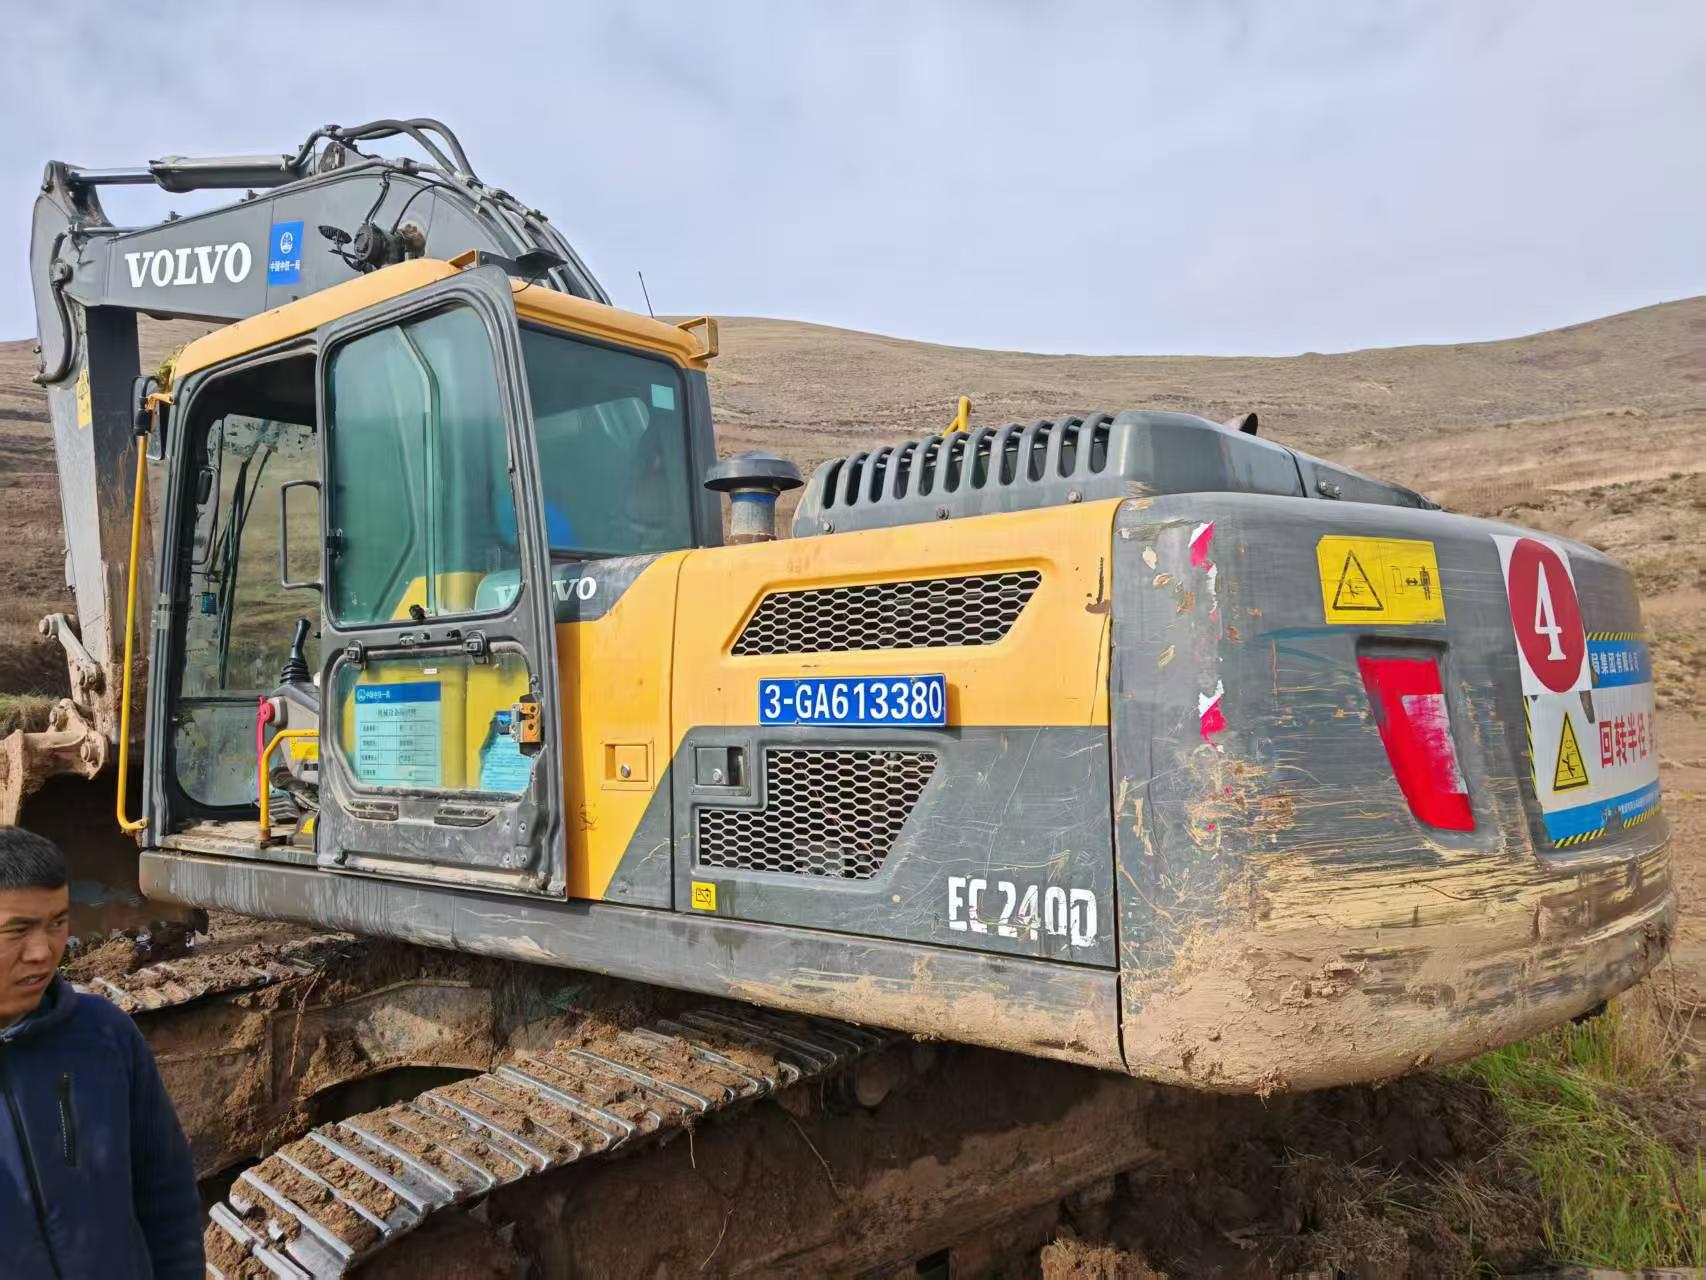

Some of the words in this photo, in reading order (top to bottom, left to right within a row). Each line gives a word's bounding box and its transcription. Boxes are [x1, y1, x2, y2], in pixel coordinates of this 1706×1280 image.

[124, 242, 252, 288] VOLVO
[1534, 560, 1567, 661] 4
[764, 680, 943, 720] 3-GA613380
